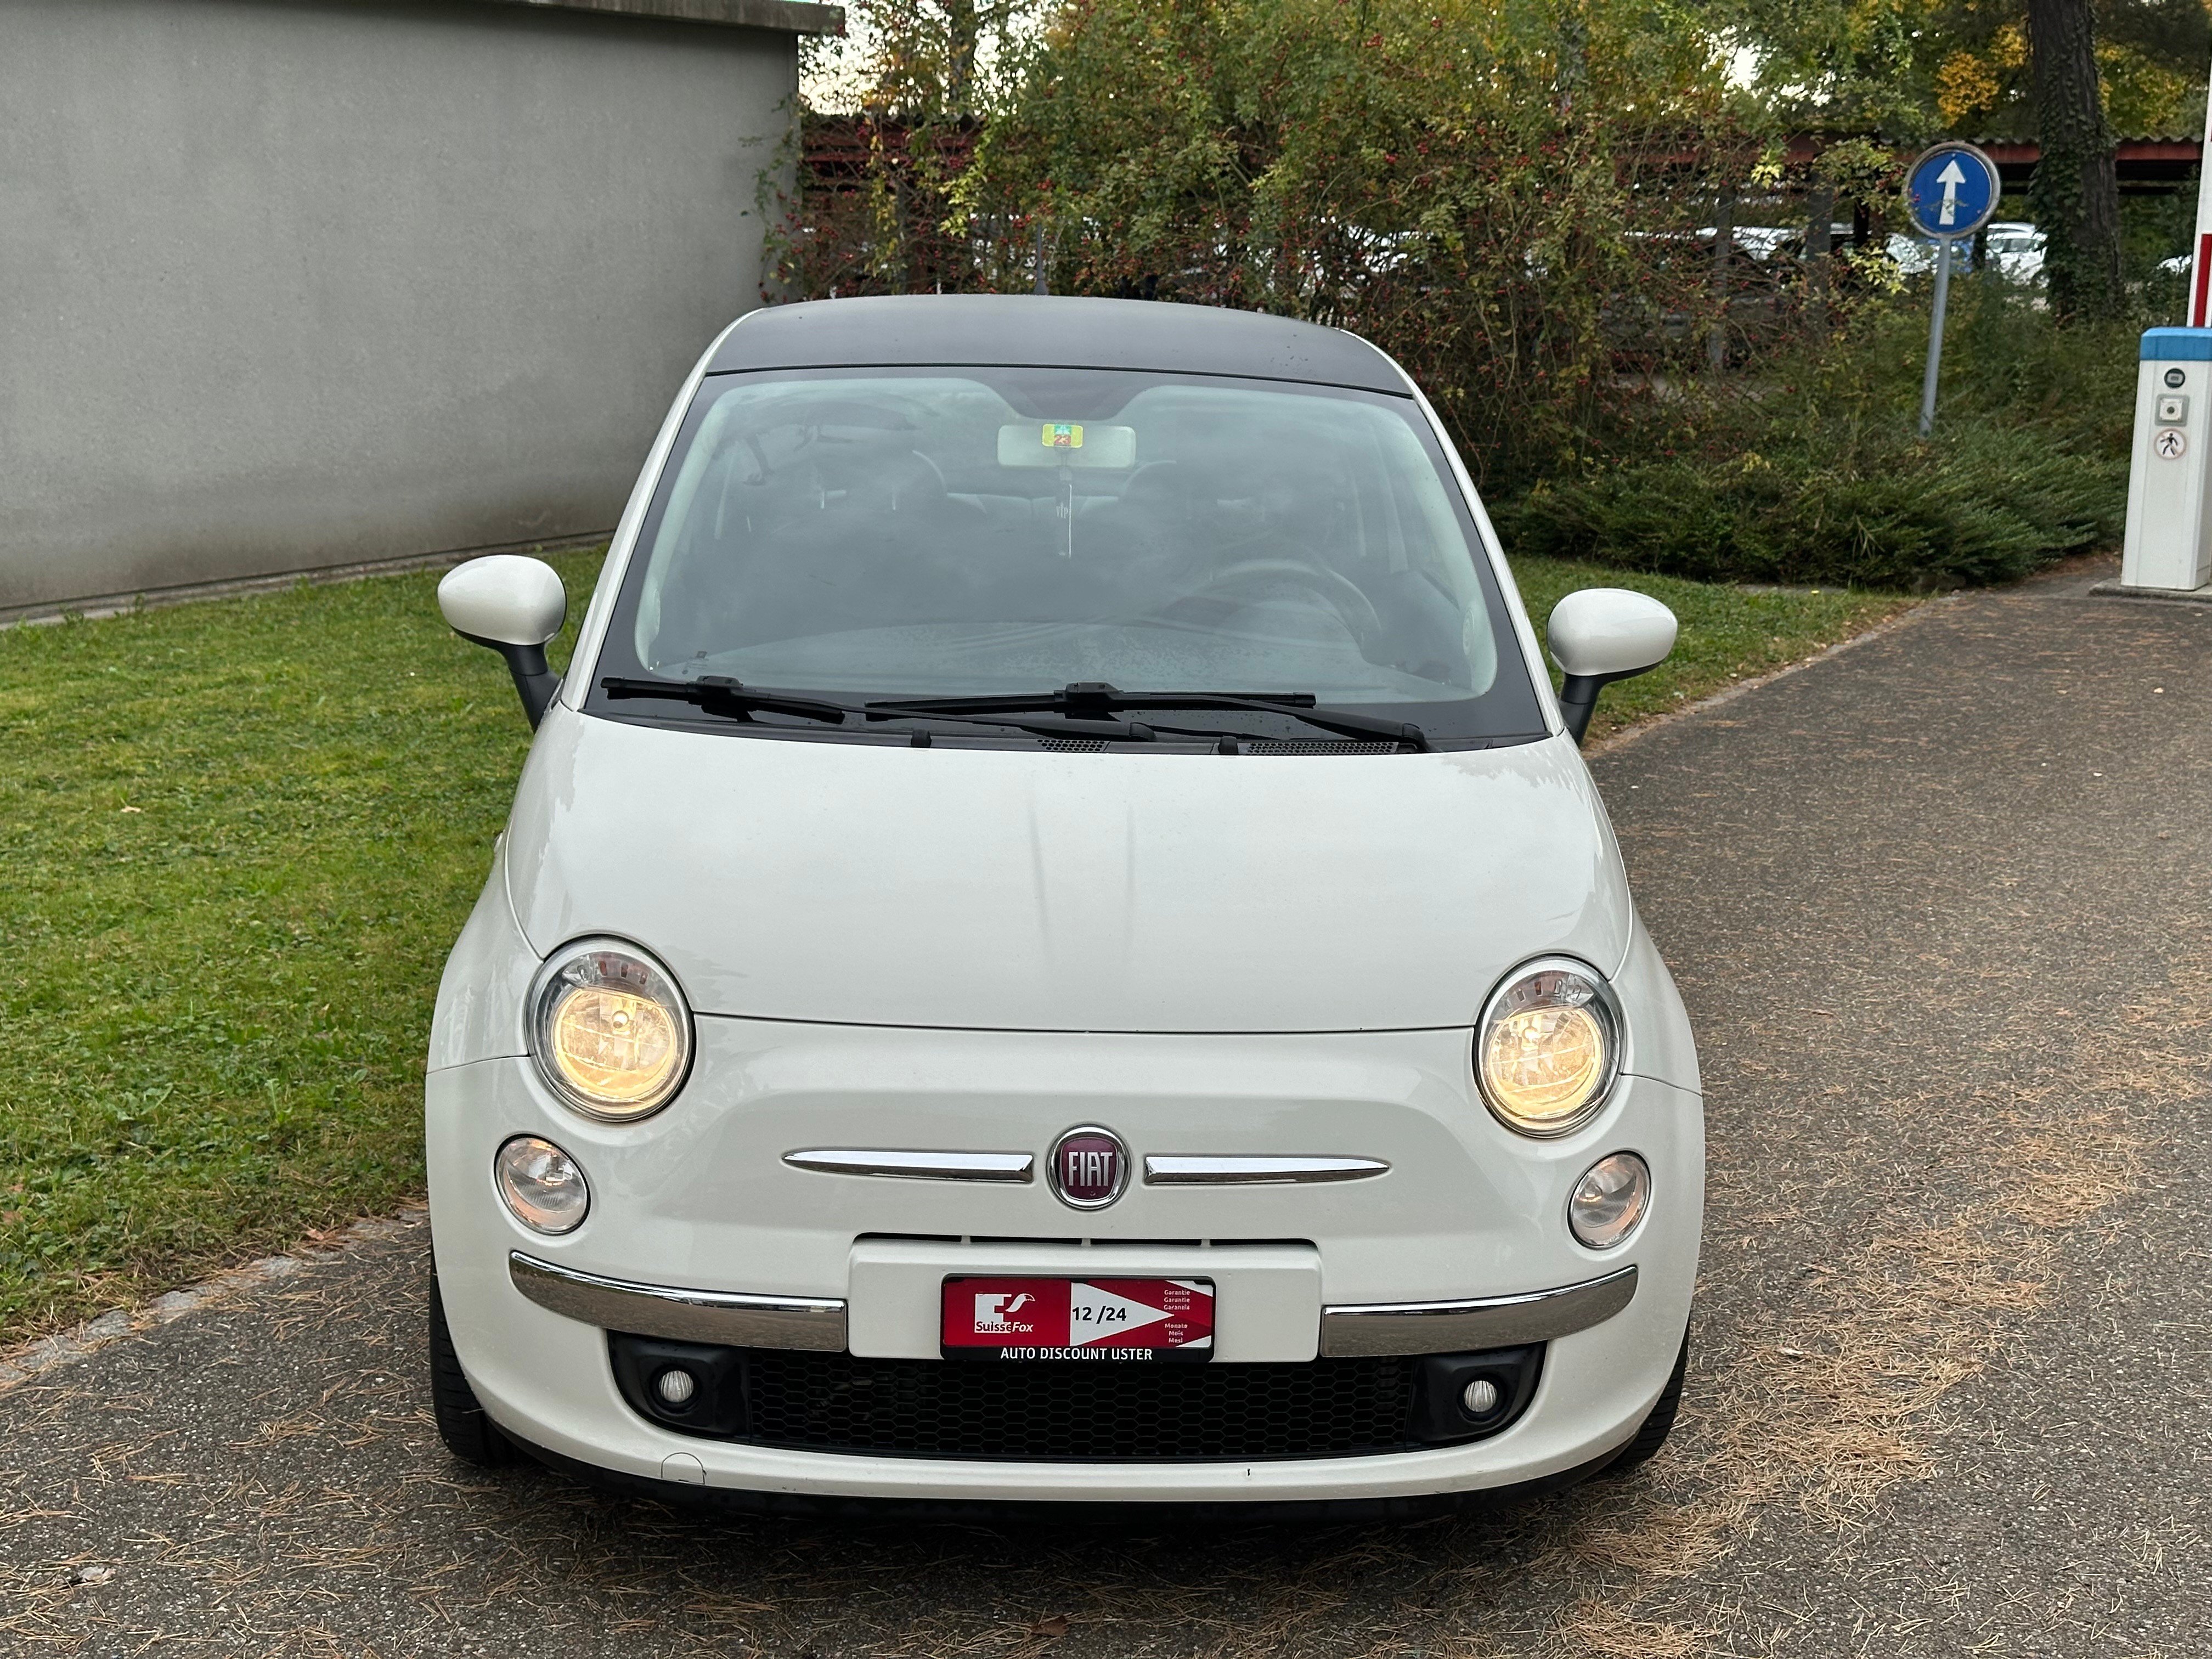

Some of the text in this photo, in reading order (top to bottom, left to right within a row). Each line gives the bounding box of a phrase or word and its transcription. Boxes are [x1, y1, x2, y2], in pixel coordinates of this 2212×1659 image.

[1068, 1152, 1113, 1187] FIAT
[976, 1321, 1034, 1332] SuisseFox
[1000, 1347, 1152, 1360] AUTO DISCOUNT USTER
